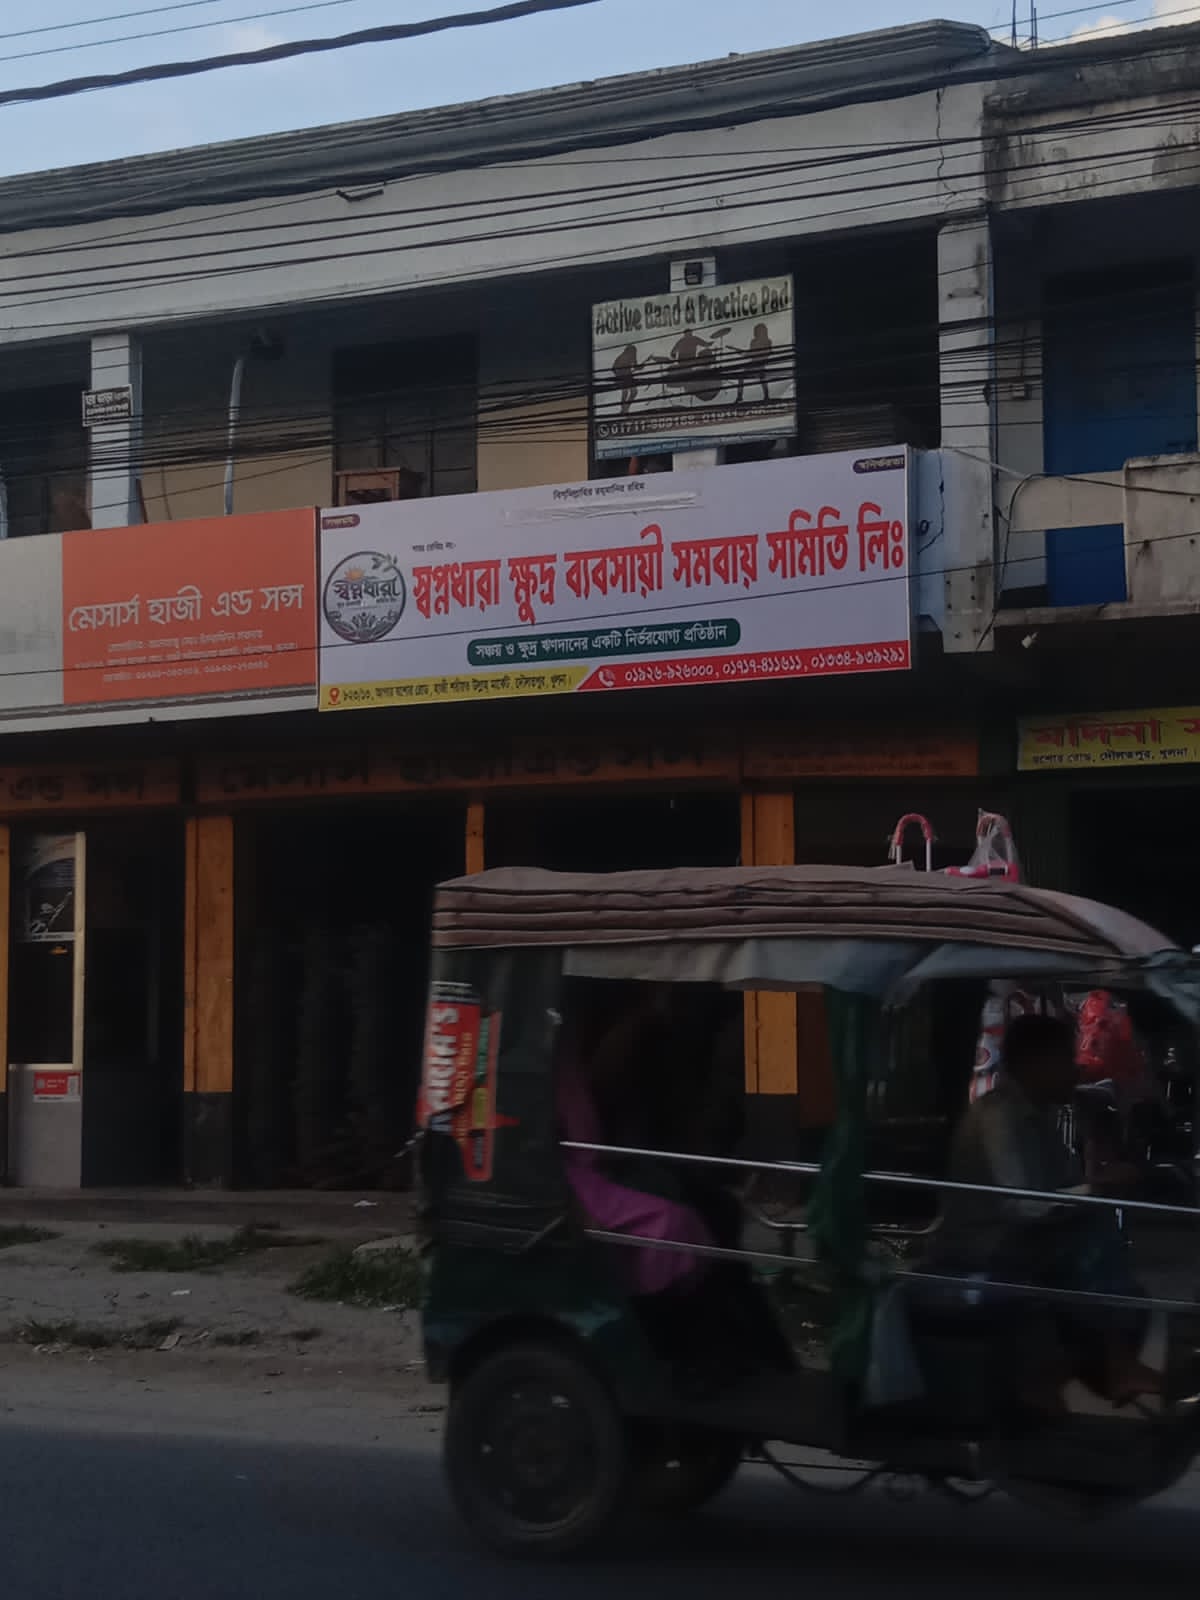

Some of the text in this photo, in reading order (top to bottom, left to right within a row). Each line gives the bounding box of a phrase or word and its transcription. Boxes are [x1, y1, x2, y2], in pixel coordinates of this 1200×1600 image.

[645, 295, 681, 329] Band
[698, 286, 758, 321] Practice
[761, 282, 789, 313] Pad
[412, 501, 904, 624] স্বপ্নধারা ক্ষুদ্র ব্যবসায়ী সমবায় সমিতি লিঃ
[69, 594, 140, 632] মেসার্স
[147, 585, 202, 625] হাজী
[260, 584, 305, 612] সন্স
[506, 643, 516, 656] ও
[518, 642, 538, 661] ক্ষুদ্র
[541, 637, 589, 655] ঋণদানের
[591, 630, 622, 650] একটি
[625, 625, 681, 647] নির্ভরযোগ্য
[683, 621, 729, 642] প্রতিষ্ঠান
